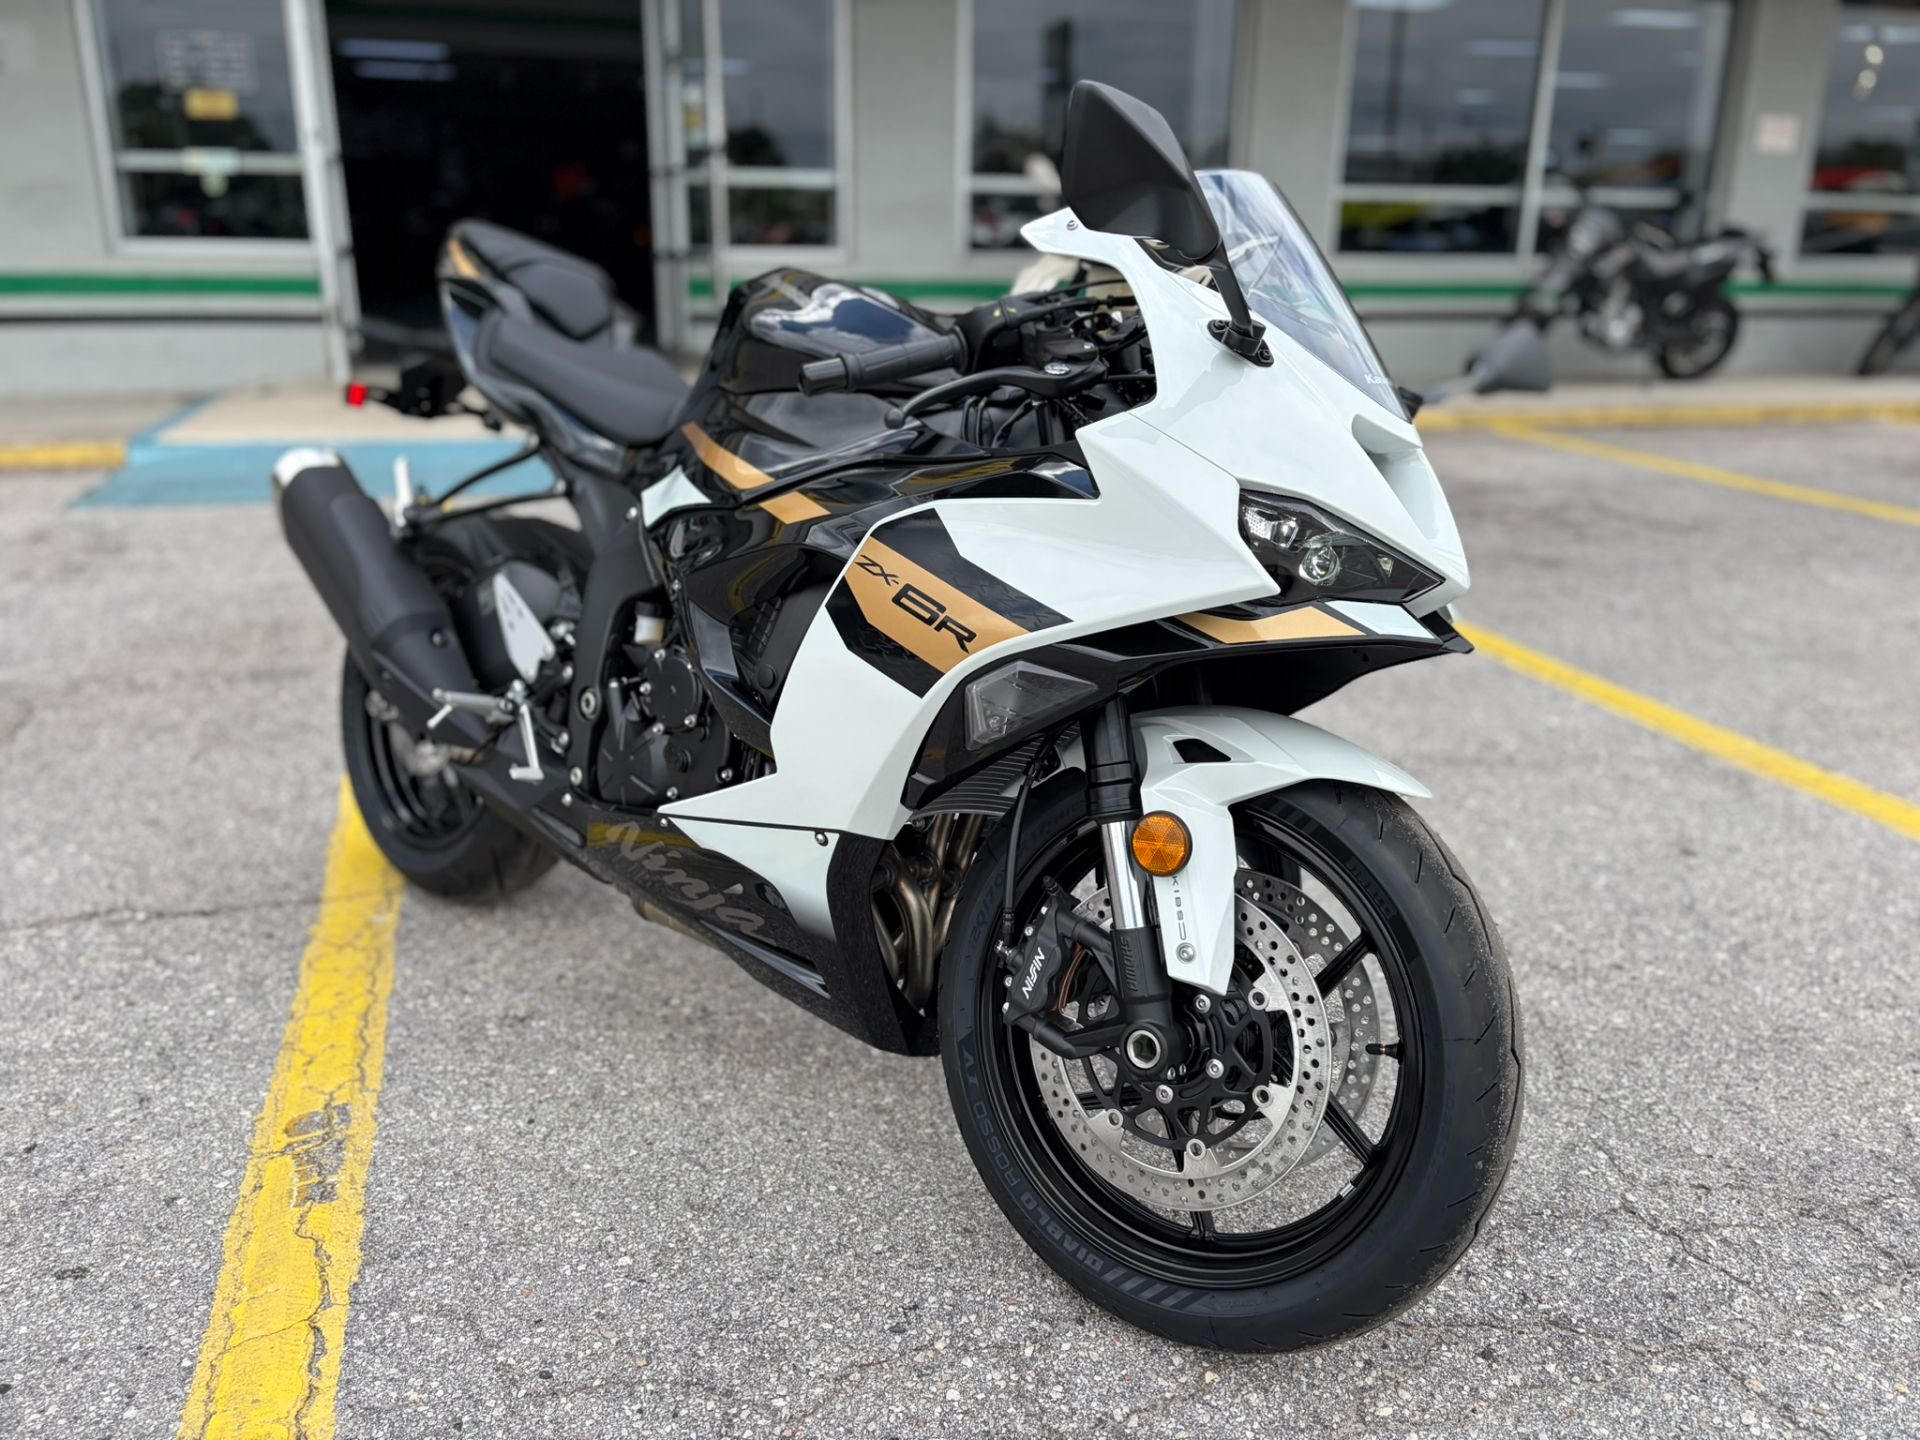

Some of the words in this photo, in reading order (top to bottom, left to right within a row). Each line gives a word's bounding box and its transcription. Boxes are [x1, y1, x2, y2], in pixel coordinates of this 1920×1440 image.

[854, 554, 977, 654] ZX-6R
[606, 820, 777, 945] Ninja
[974, 1102, 1020, 1188] ROSSO
[1021, 1191, 1104, 1274] DIABLO
